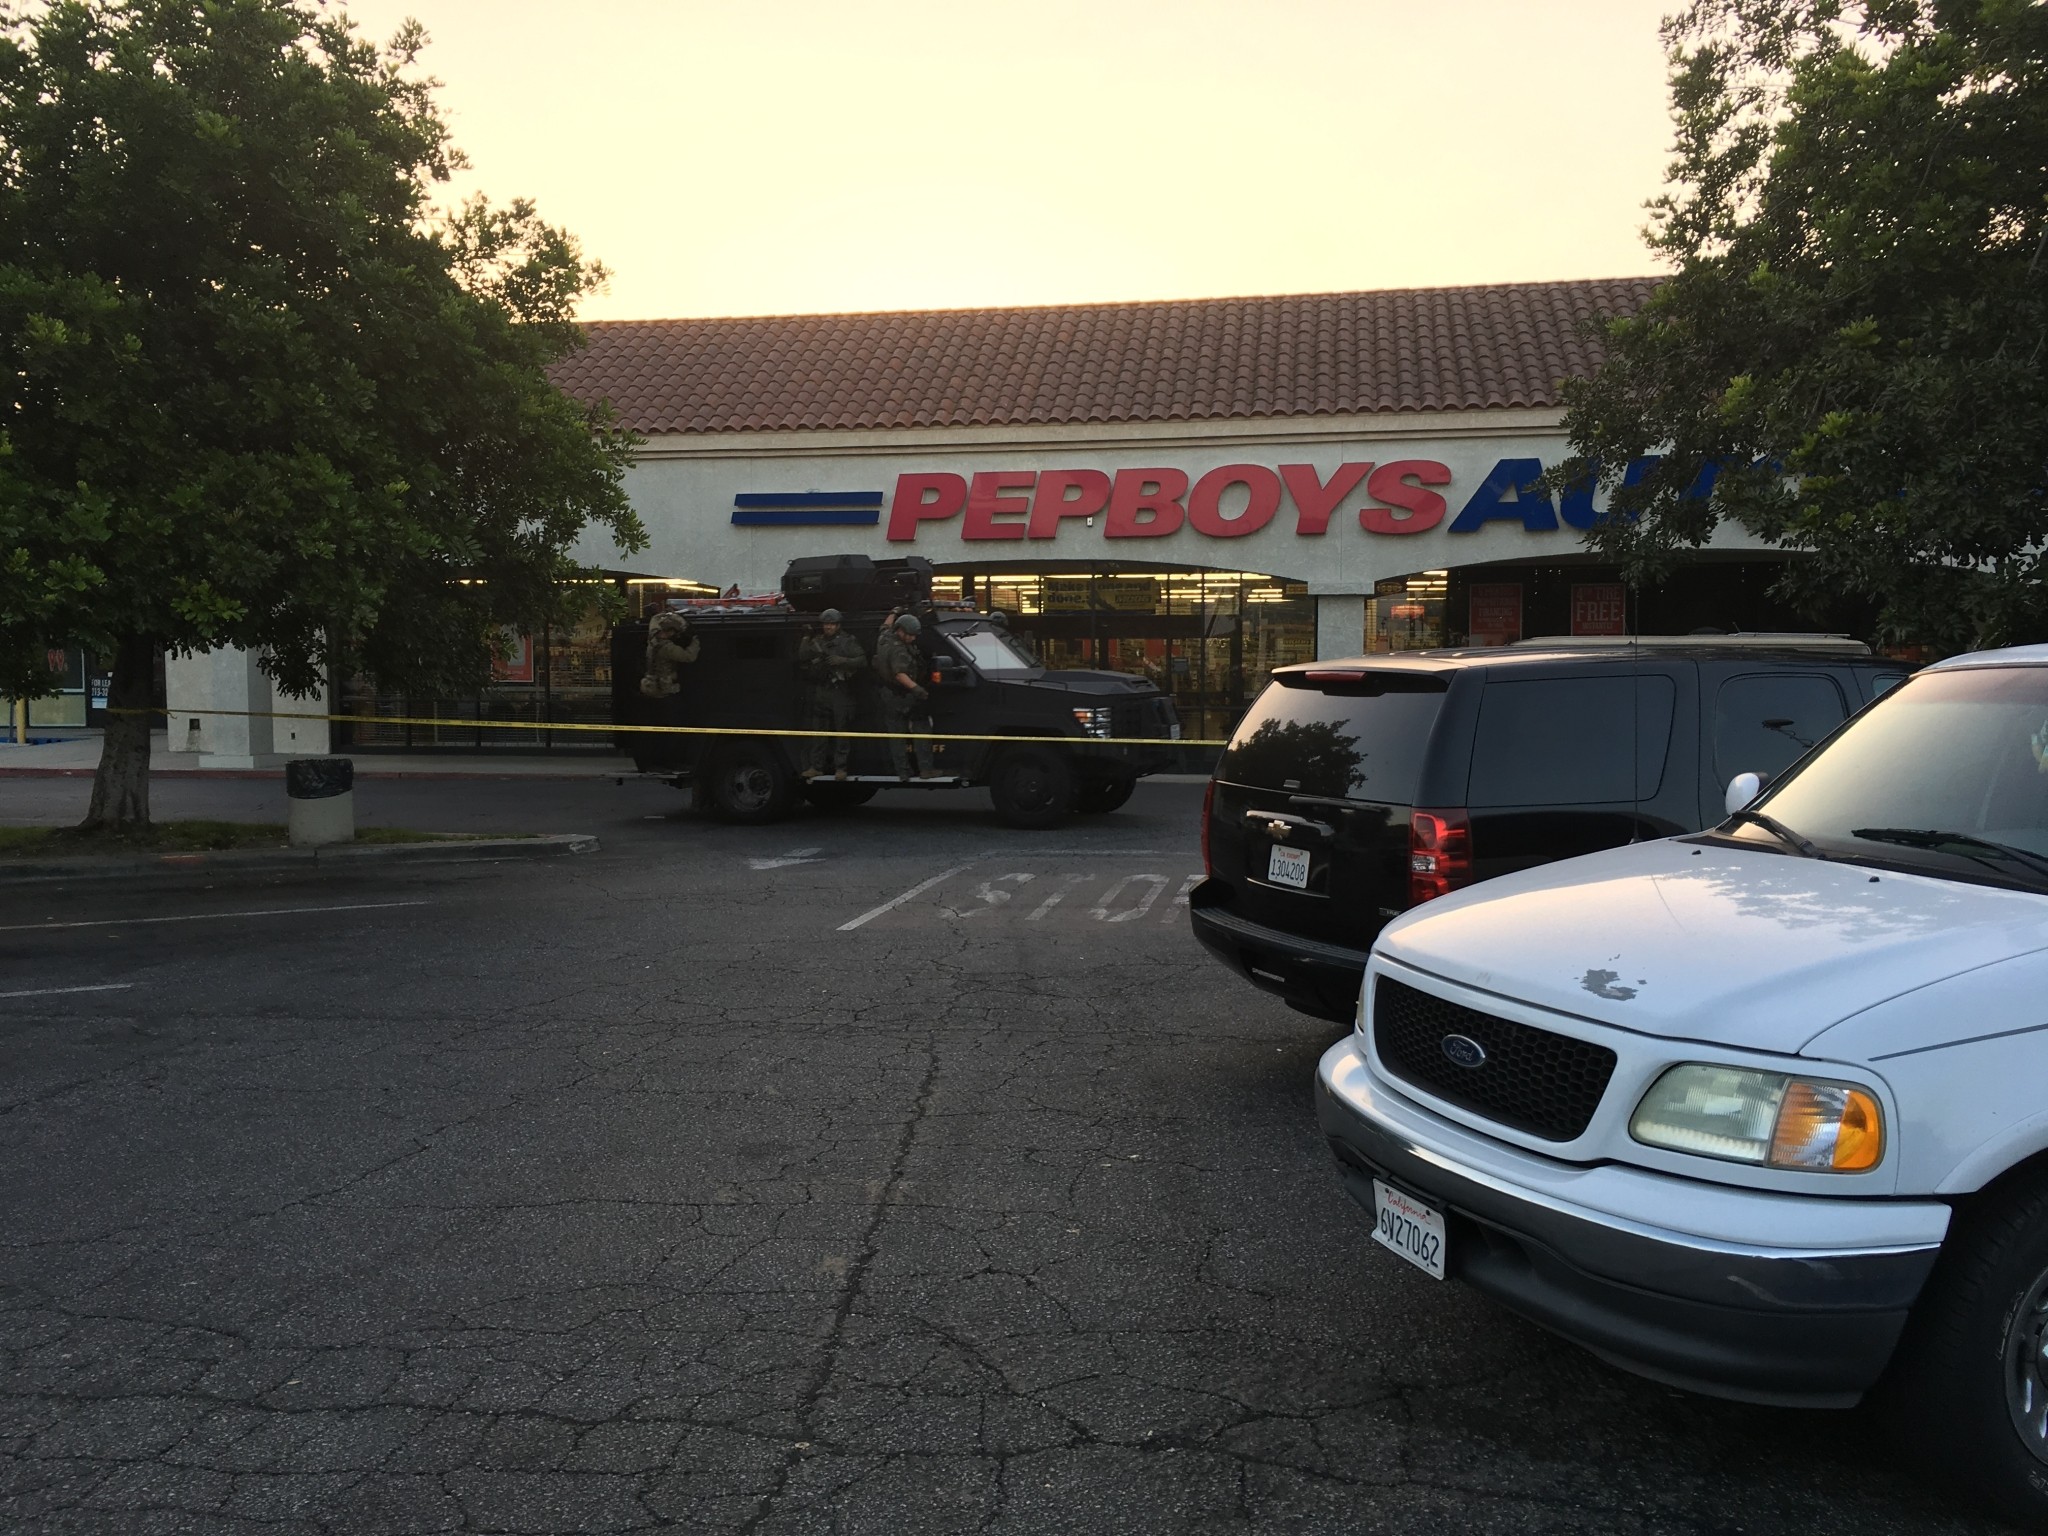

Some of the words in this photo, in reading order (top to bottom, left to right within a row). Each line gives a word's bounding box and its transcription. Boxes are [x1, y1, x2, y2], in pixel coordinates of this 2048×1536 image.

[888, 460, 1452, 541] PEPBOYS
[1575, 601, 1621, 622] FREE
[1271, 859, 1306, 882] 1304208
[1450, 1040, 1474, 1062] Ford
[1387, 1190, 1430, 1221] California
[1381, 1207, 1440, 1268] 6V27062
